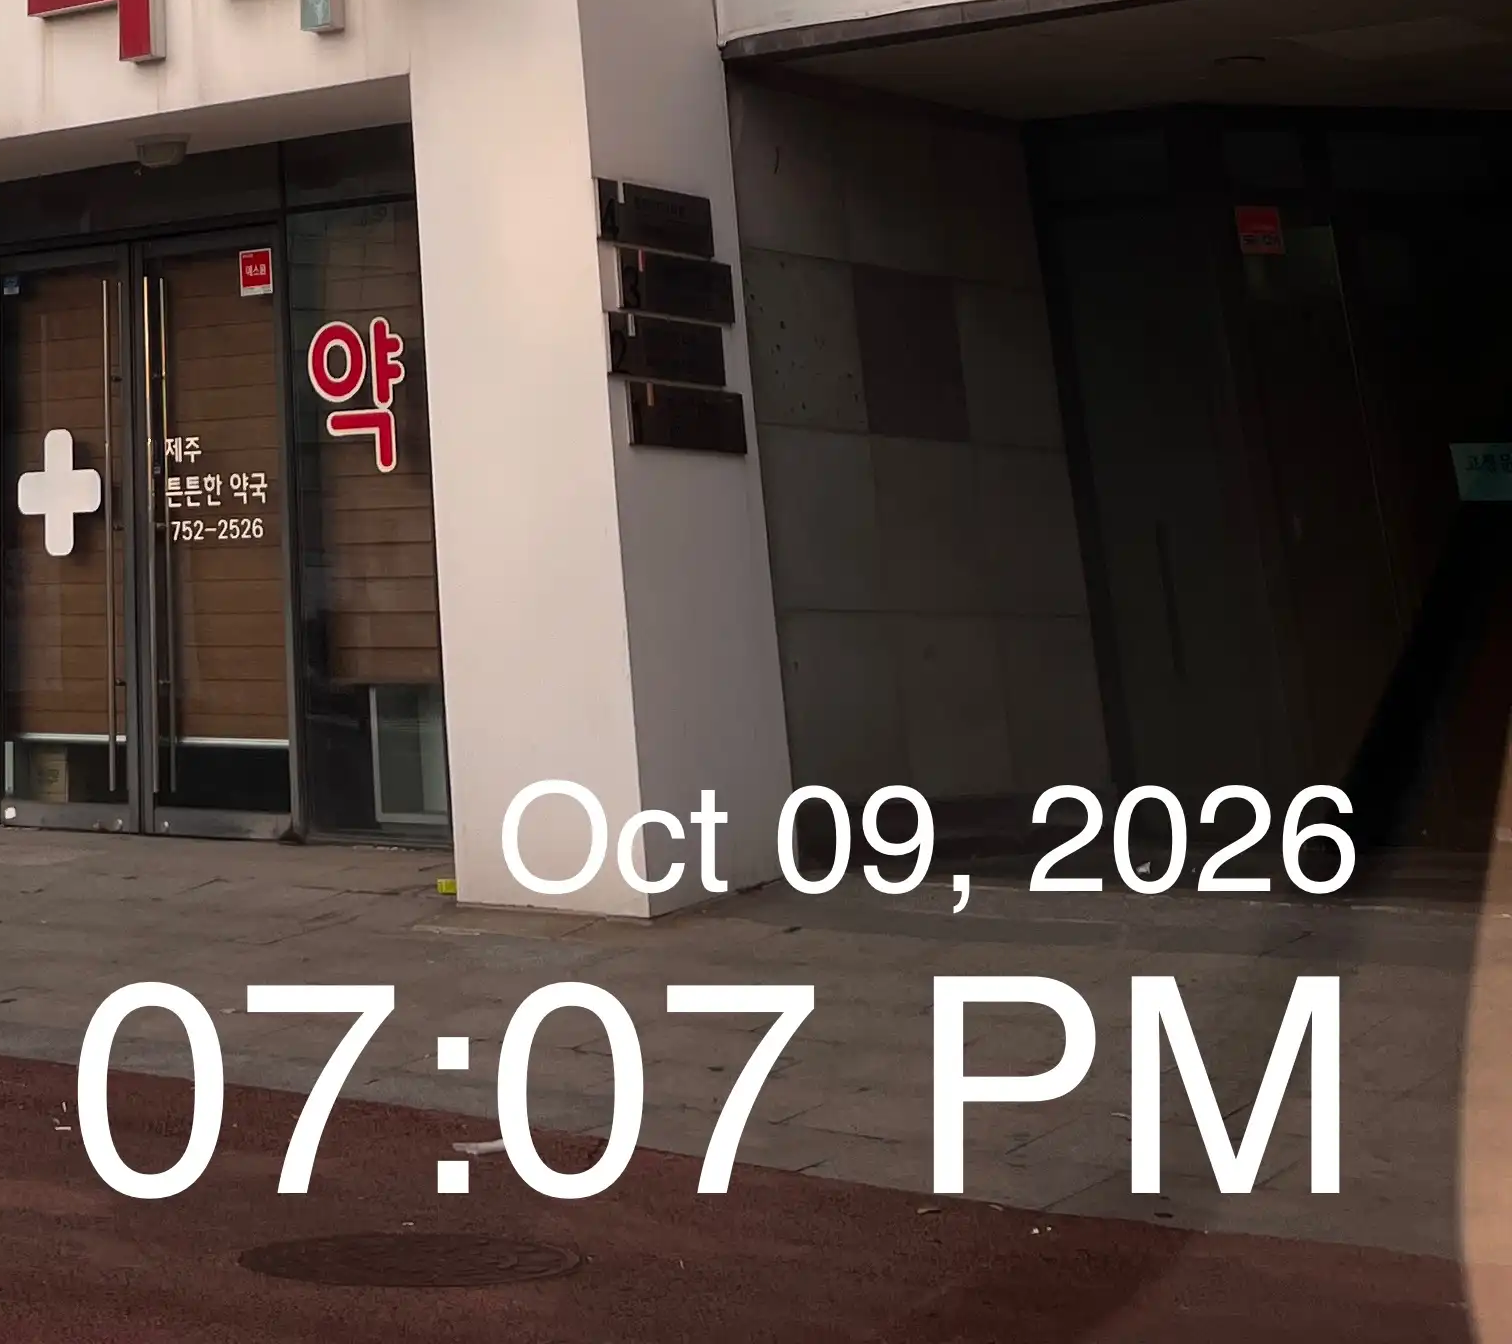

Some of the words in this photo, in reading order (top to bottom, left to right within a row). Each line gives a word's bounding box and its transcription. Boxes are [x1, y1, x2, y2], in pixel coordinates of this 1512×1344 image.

[306, 315, 407, 475] 약
[165, 435, 203, 464] 제주
[164, 472, 223, 509] 튼튼한
[229, 471, 269, 506] 약국
[170, 517, 266, 542] 752-2526
